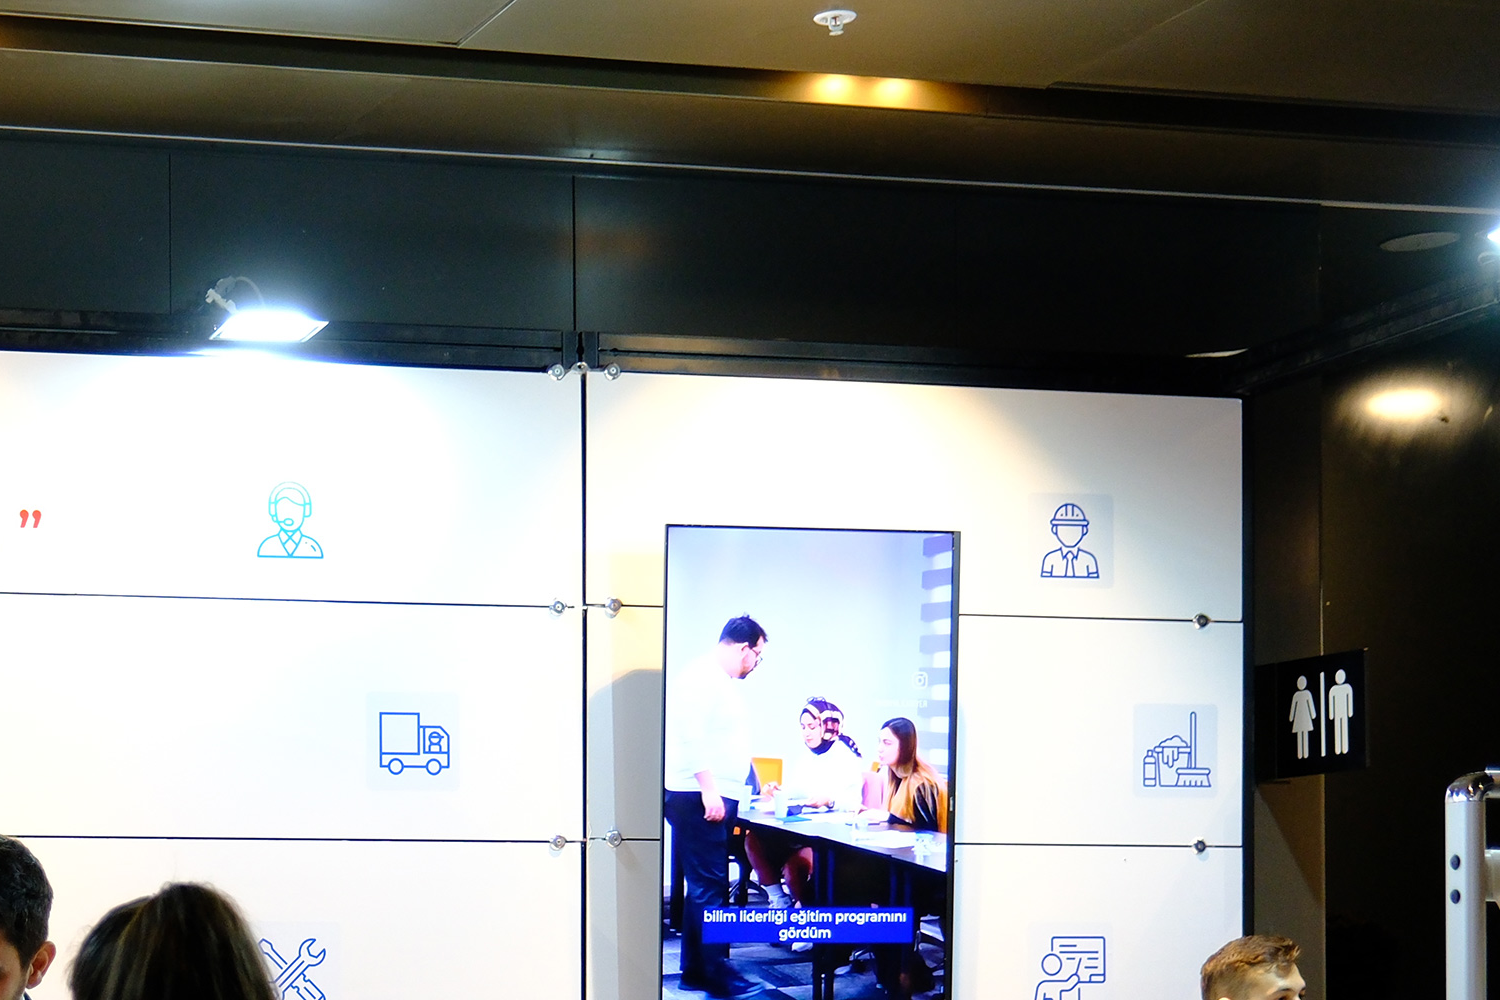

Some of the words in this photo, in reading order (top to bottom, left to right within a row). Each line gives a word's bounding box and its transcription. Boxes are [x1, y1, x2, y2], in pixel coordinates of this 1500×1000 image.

[703, 910, 737, 923] bilim
[739, 910, 788, 925] liderliği
[789, 910, 833, 925] eğitim
[834, 911, 907, 925] programını
[778, 927, 832, 942] gördüm
